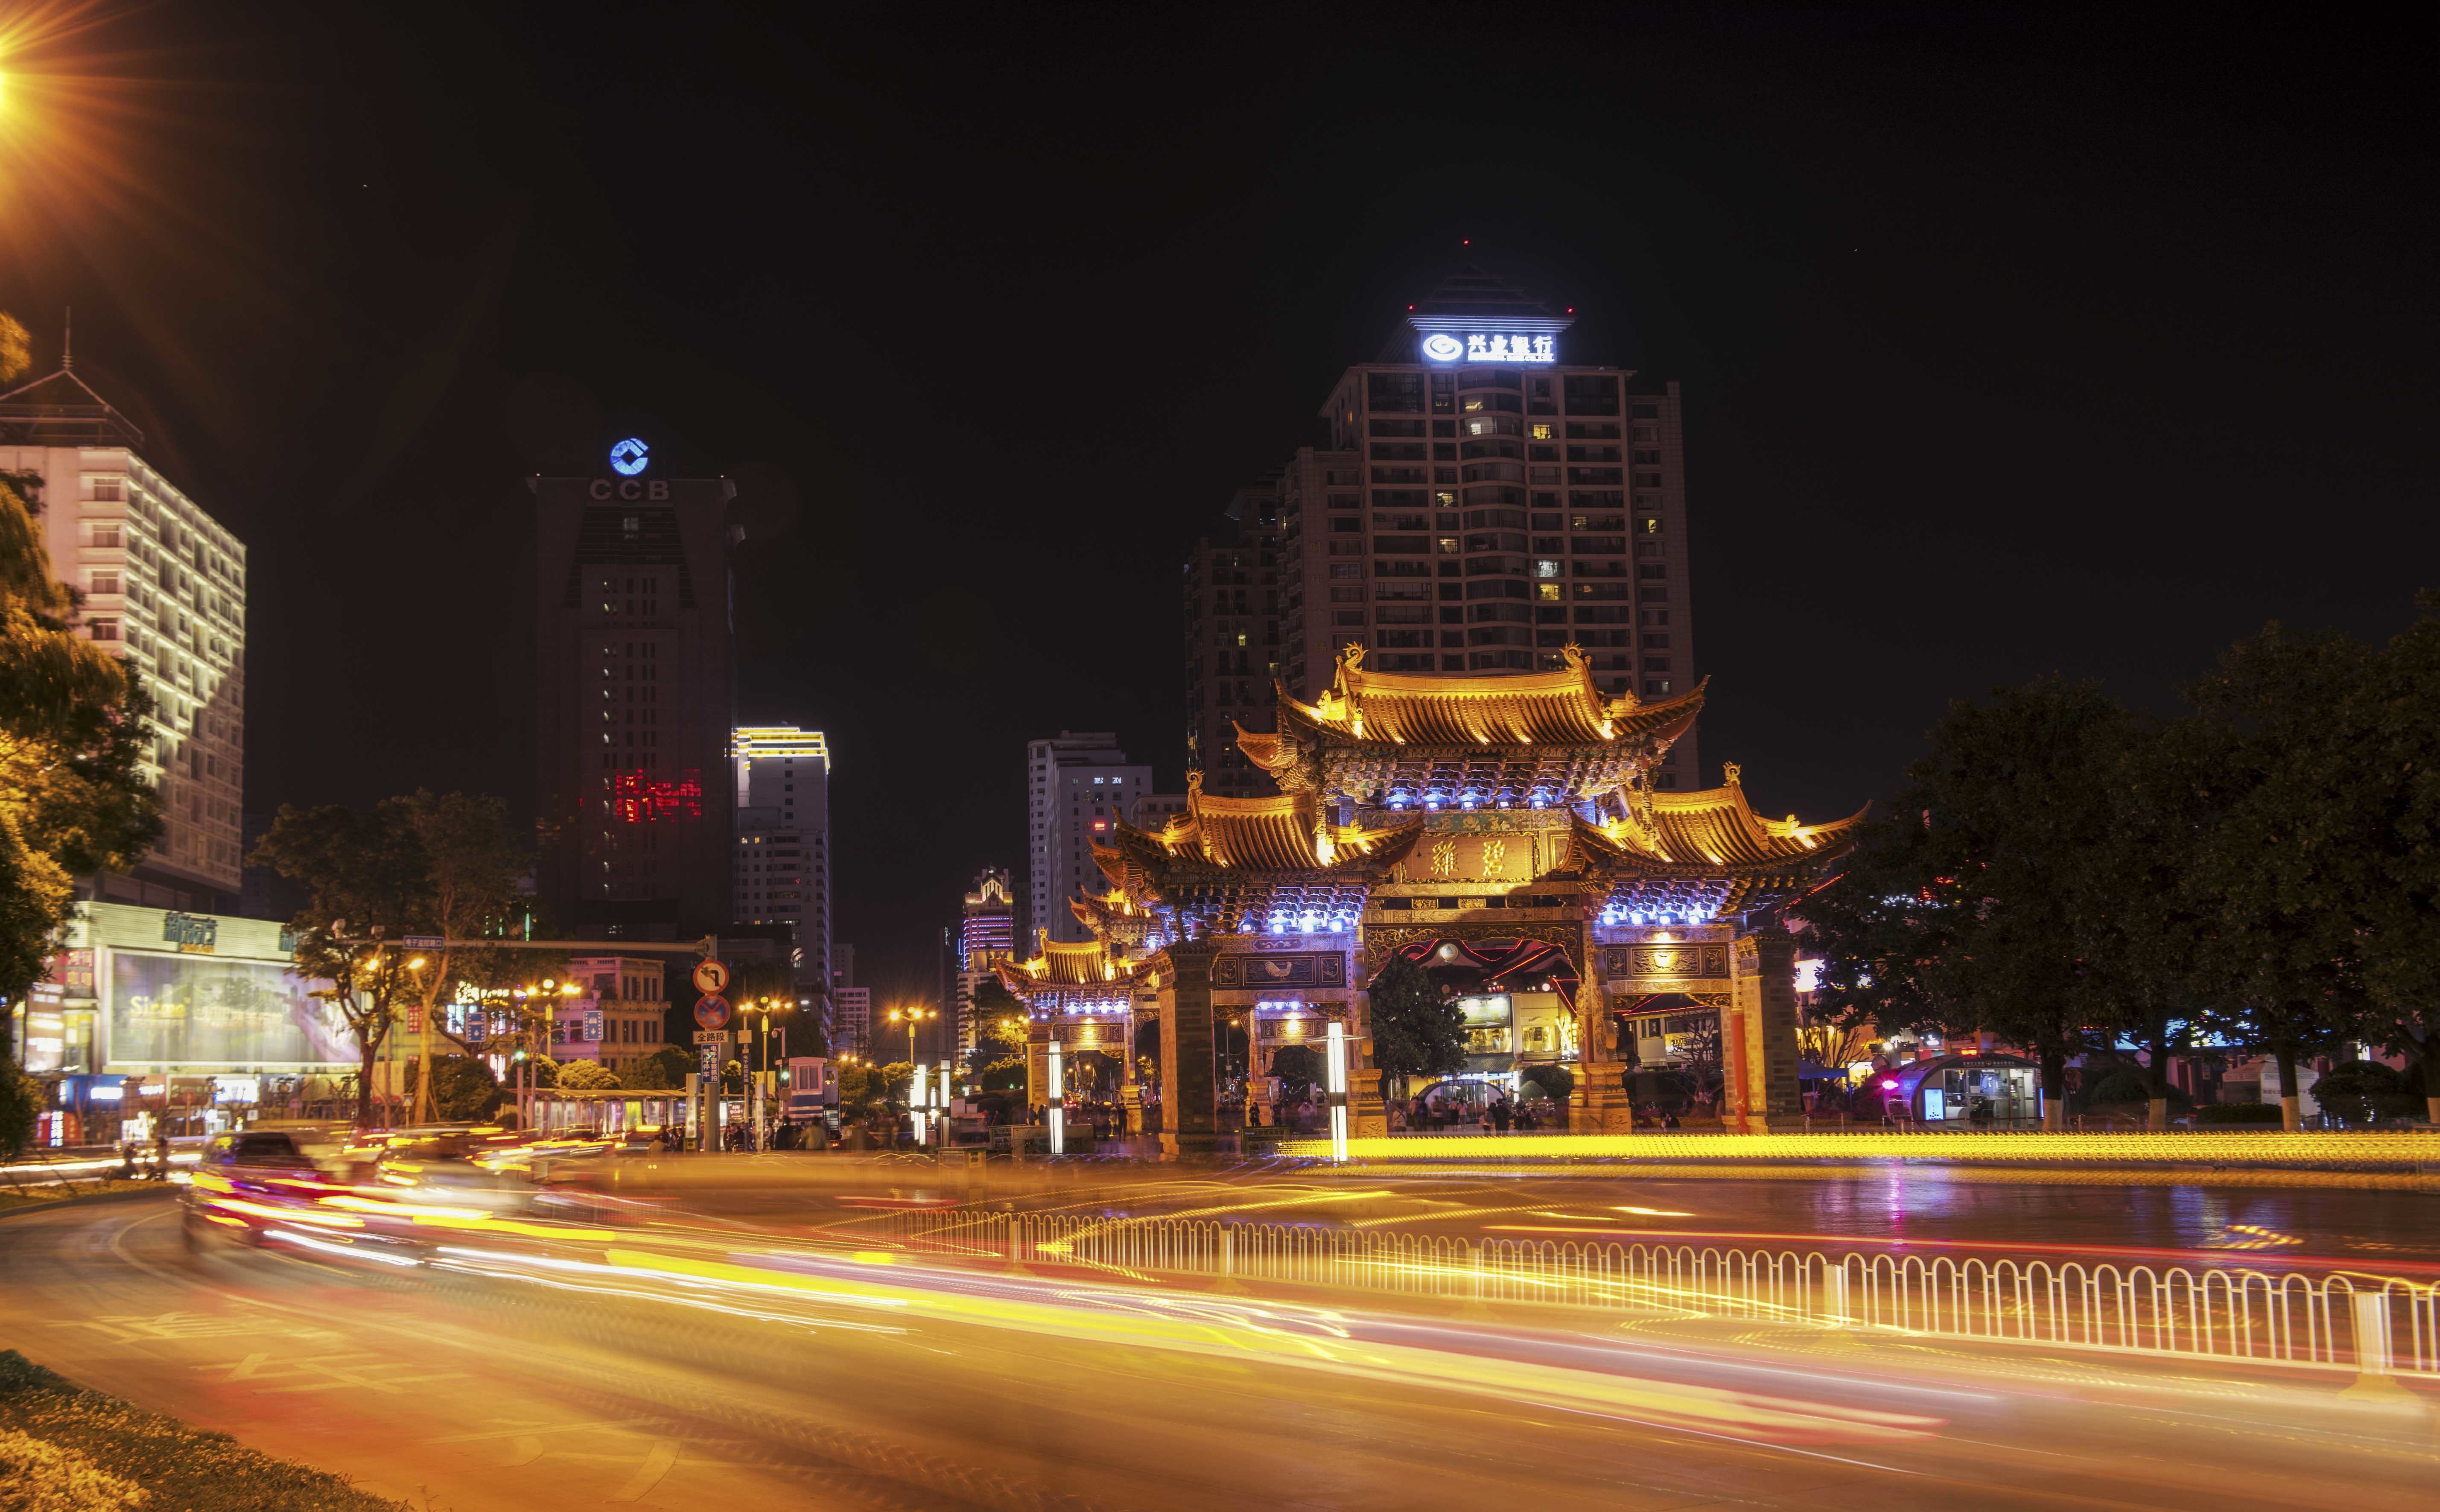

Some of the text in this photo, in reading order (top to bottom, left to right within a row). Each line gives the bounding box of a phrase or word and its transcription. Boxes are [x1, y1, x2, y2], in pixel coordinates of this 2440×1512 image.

[1467, 335, 1553, 354] 兴业银行
[590, 479, 669, 500] CCB
[698, 1032, 725, 1042] 全路段
